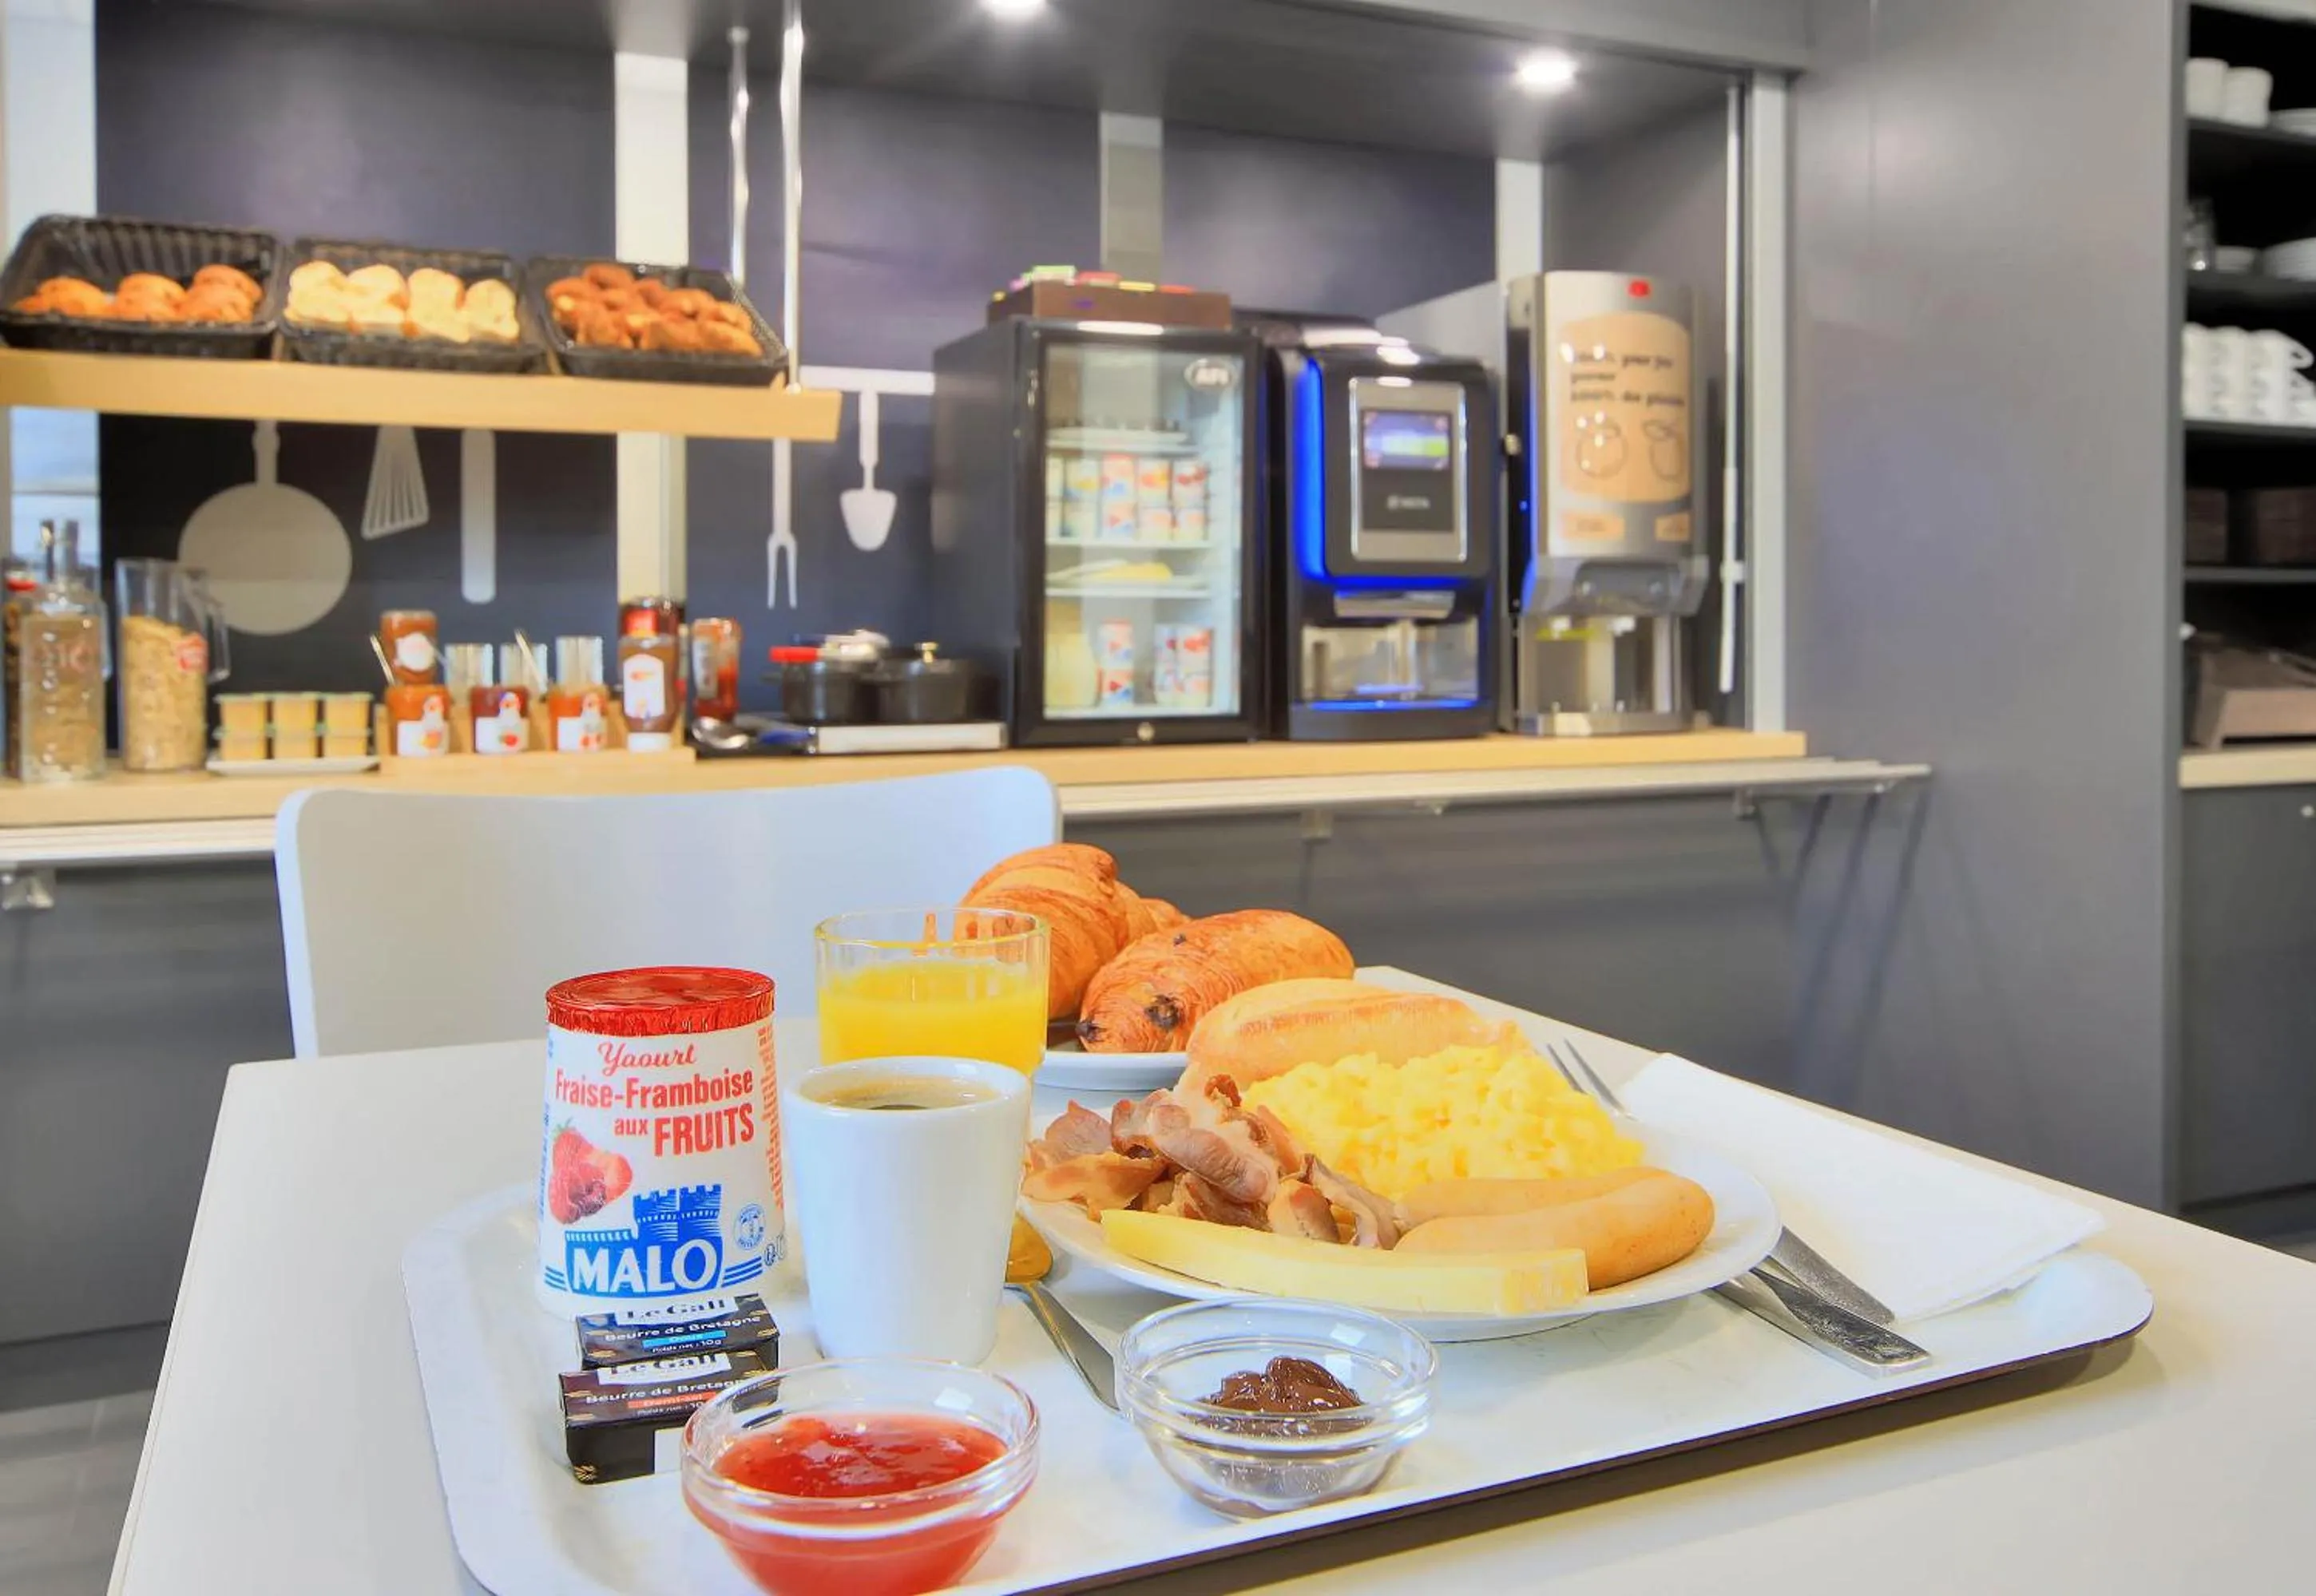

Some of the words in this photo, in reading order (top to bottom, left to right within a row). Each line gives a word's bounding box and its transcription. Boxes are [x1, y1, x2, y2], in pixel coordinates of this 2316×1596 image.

[597, 1042, 696, 1076] Yaourt
[555, 1068, 752, 1109] Fraise-Framboise
[614, 1119, 648, 1135] aux
[654, 1102, 755, 1158] FRUITS
[573, 1238, 717, 1293] MALO
[605, 1329, 660, 1342] Beurre
[664, 1325, 685, 1335] de
[689, 1316, 761, 1332] Bretagne
[585, 1390, 646, 1404] Beurre
[651, 1386, 672, 1396] de
[677, 1379, 741, 1393] Bretag
